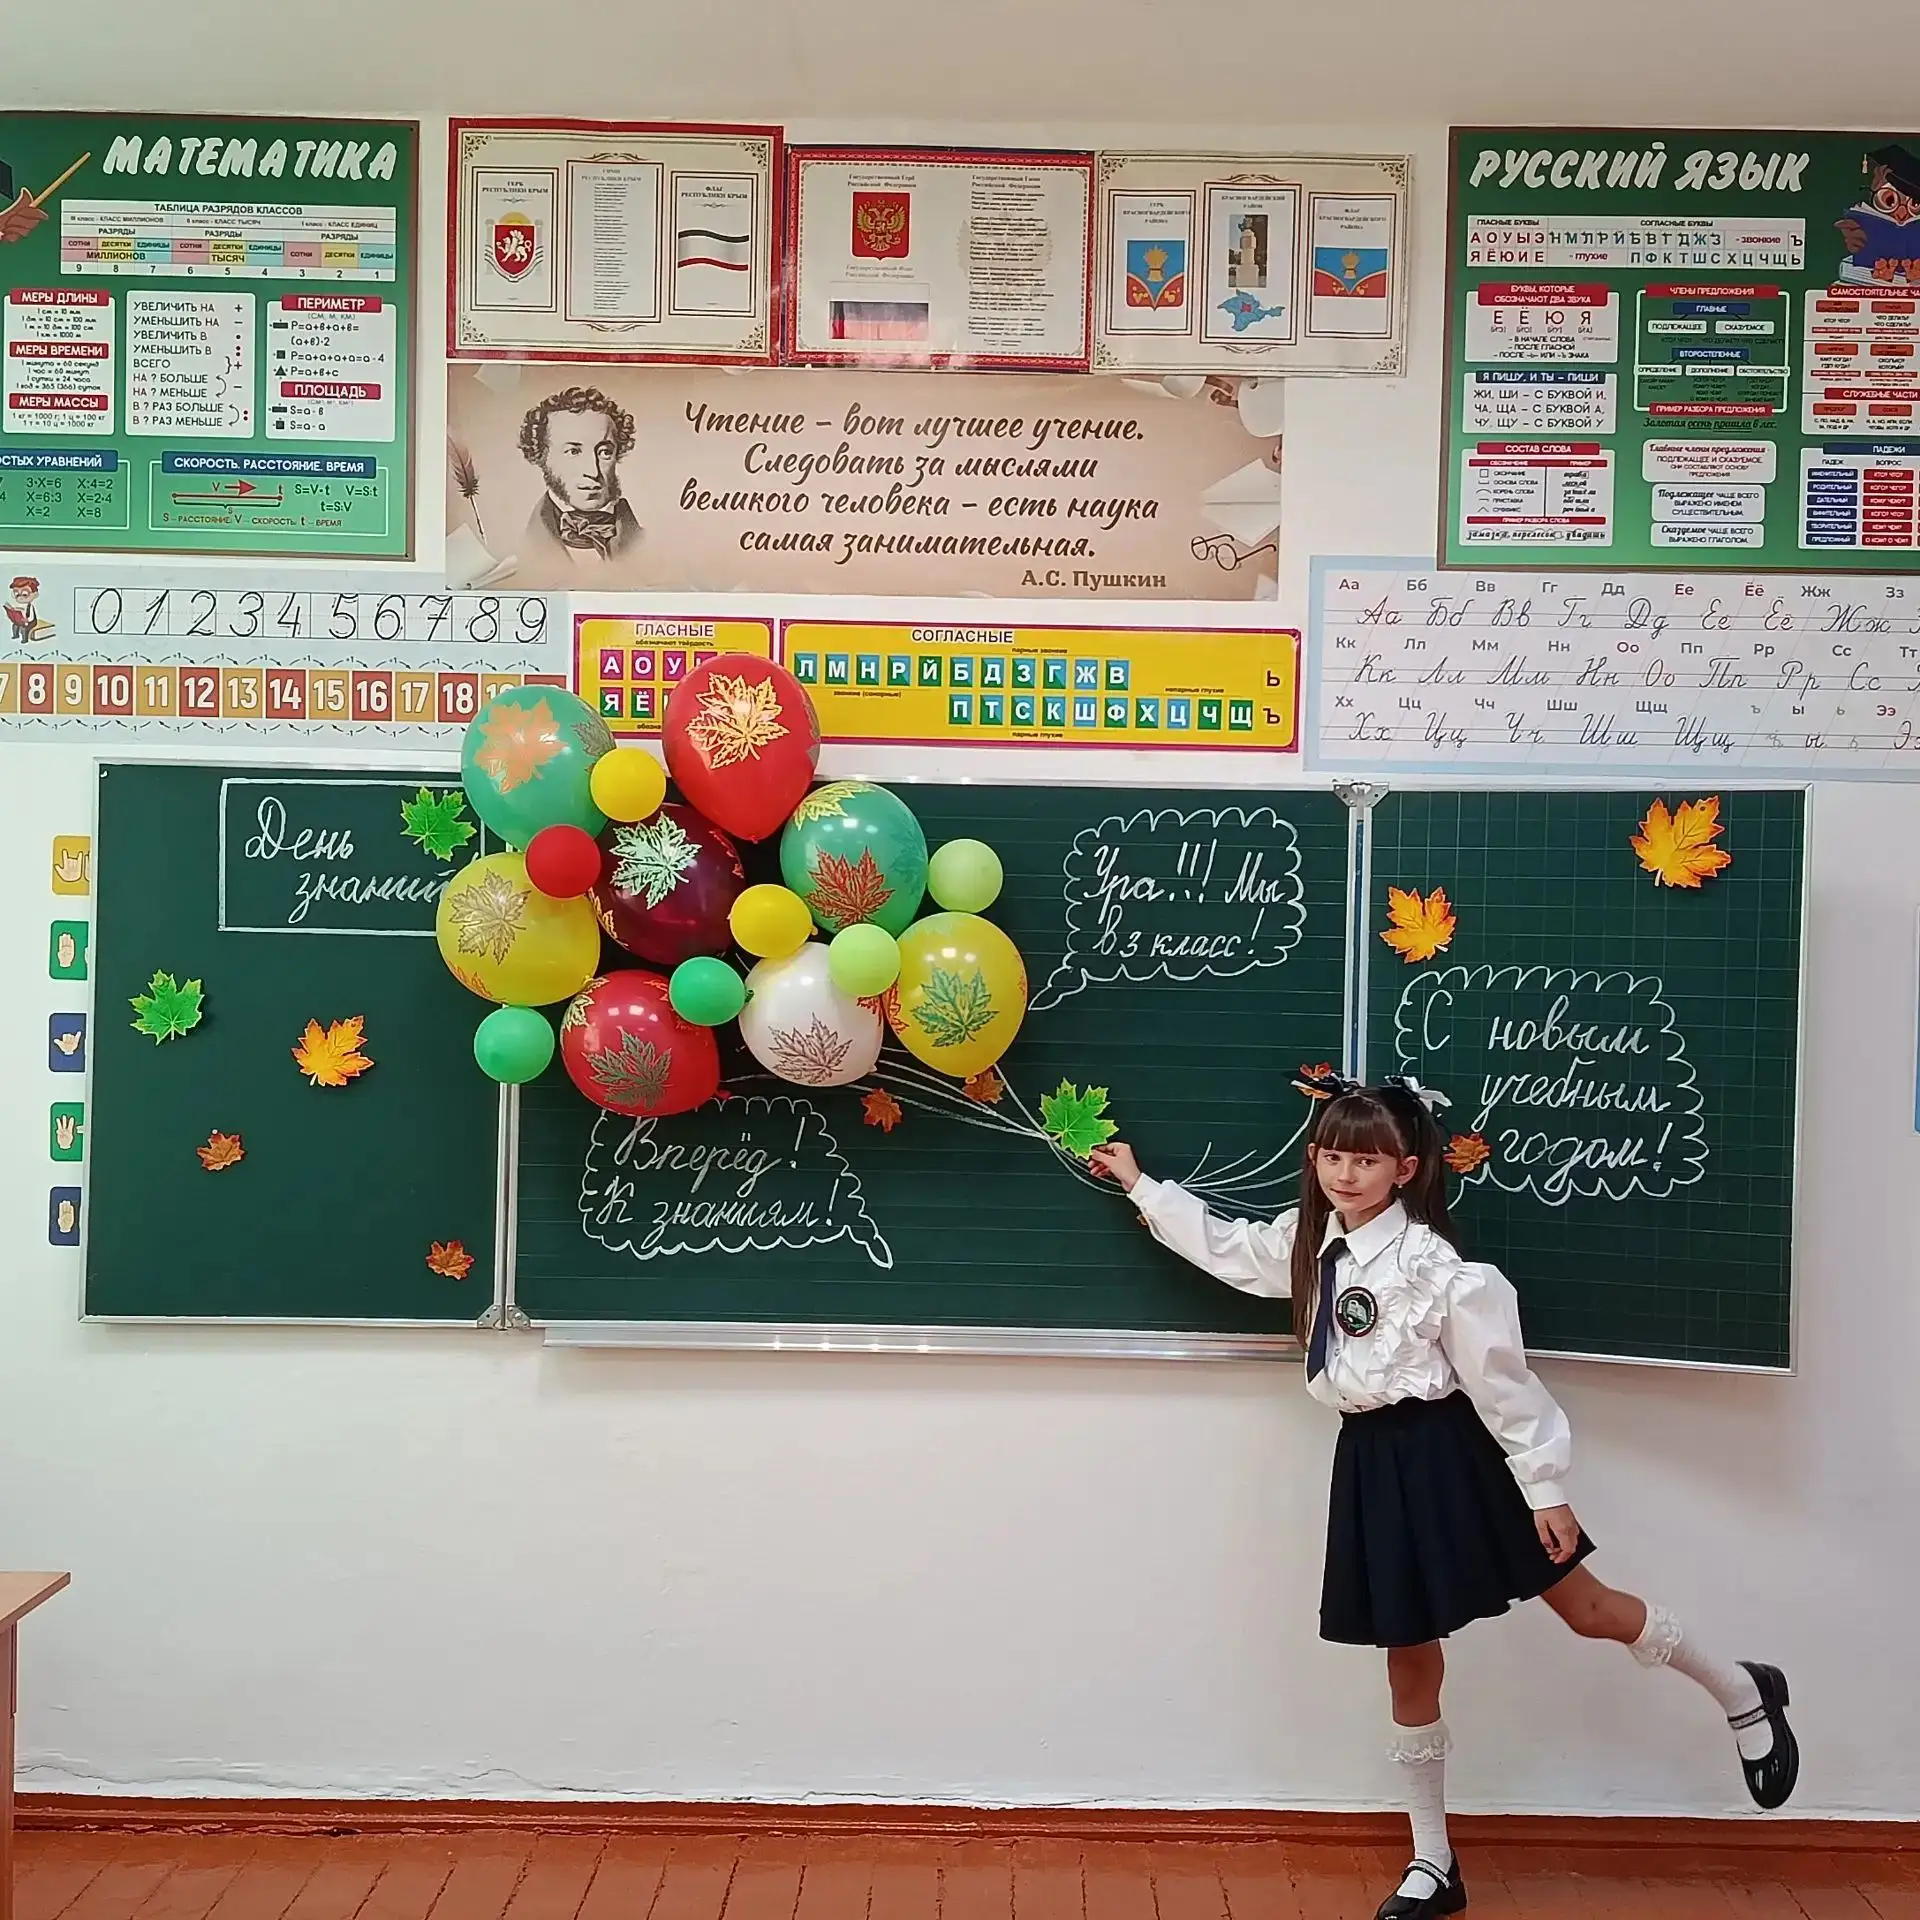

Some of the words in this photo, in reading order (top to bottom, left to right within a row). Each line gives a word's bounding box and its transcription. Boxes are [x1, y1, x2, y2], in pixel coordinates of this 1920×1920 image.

[102, 135, 397, 181] МАТЕМАТИКА
[1470, 141, 1667, 189] РУССКИЙ
[1675, 150, 1811, 192] ЯЗЫК
[154, 203, 200, 214] ТАБЛИЦА
[202, 204, 254, 215] РАЗРЯДОВ
[256, 206, 303, 216] КЛАССОВ
[98, 228, 136, 236] РАЗРЯДЫ
[204, 230, 243, 239] РАЗРЯДЫ
[321, 233, 359, 241] РАЗРЯДЫ
[86, 251, 146, 261] МИЛЛИОНОВ
[211, 254, 246, 263] ТЫСЯЧ
[1539, 285, 1575, 293] КОТОРЫЕ
[1669, 287, 1695, 295] ЧЛЕНЫ
[1697, 288, 1755, 296] ПРЕДЛОЖЕНИЯ
[1830, 288, 1909, 297] САМОСТОЯТЕЛЬНЫЕ
[22, 292, 53, 303] МЕРЫ
[57, 293, 98, 304] ДЛИНЫ
[297, 297, 366, 310] ПЕРИМЕТР
[1494, 295, 1548, 304] ОБОЗНАЧАЮТ
[1549, 296, 1565, 304] ДВА
[1567, 296, 1591, 304] ЗВУКА
[133, 301, 197, 312] УВЕЛИЧИТЬ
[200, 303, 215, 312] НА
[1696, 305, 1727, 313] ГЛАВНЫЕ
[133, 316, 202, 327] УМЕНЬШИТЬ
[205, 318, 220, 327] НА
[1652, 323, 1703, 331] ПОДЛЕЖАЩЕЕ
[133, 330, 197, 340] УВЕЛИЧИТЬ
[200, 331, 208, 341] В
[16, 345, 47, 355] МЕРЫ
[50, 346, 103, 356] ВРЕМЕНИ
[133, 344, 202, 355] УМЕНЬШИТЬ
[205, 346, 212, 355] В
[133, 359, 171, 368] ВСЕГО
[133, 373, 147, 382] НА
[160, 374, 208, 384] БОЛЬШЕ
[1483, 373, 1490, 381] Я
[1492, 373, 1527, 383] ПИШУ,
[1541, 374, 1554, 382] ТЫ
[1567, 373, 1599, 382] ПИШИ
[133, 388, 147, 396] НА
[160, 388, 207, 398] МЕНЬШЕ
[294, 384, 367, 399] ПЛОЩАДЬ
[1473, 390, 1495, 400] ЖИ,
[1499, 390, 1518, 399] ШИ
[1534, 390, 1544, 399] С
[1547, 388, 1592, 400] БУКВОЙ
[1892, 391, 1918, 399] ЧАСТИ
[19, 397, 51, 407] МЕРЫ
[54, 398, 99, 408] МАССЫ
[684, 401, 805, 437] Чтение
[843, 401, 904, 437] вот
[913, 417, 1023, 452] лучшее
[1032, 417, 1144, 453] учение.
[1505, 445, 1540, 454] СОСТАВ
[1541, 445, 1572, 454] СЛОВА
[1873, 445, 1906, 454] ПАДЕЖИ
[36, 454, 102, 468] УРАВНЕНИЙ
[174, 457, 241, 469] СКОРОСТЬ.
[243, 459, 323, 472] РАССТОЯНИЕ.
[326, 462, 364, 473] ВРЕМЯ
[744, 442, 904, 486] Следовать
[914, 454, 944, 488] за
[955, 455, 1101, 479] мыслями
[679, 478, 811, 516] великого
[821, 481, 950, 517] человека
[988, 495, 1057, 519] есть
[1068, 495, 1159, 531] наука
[739, 530, 833, 554] самая
[834, 531, 1095, 565] занимательная.
[1021, 569, 1067, 588] А.С.
[1072, 570, 1167, 591] Пушкин
[1338, 578, 1360, 590] Аа
[1406, 578, 1428, 592] Бб
[1475, 581, 1496, 593] Вв
[1542, 581, 1558, 593] Гг
[1601, 583, 1625, 596] Дд
[1675, 584, 1694, 596] Ее
[1745, 582, 1764, 597] Ёё
[1801, 586, 1832, 598] Жж
[1885, 587, 1905, 599] Зз
[91, 588, 122, 634] 0
[145, 589, 169, 635] 1
[186, 590, 217, 636] 2
[229, 591, 264, 637] 3
[278, 593, 301, 638] 4
[329, 593, 359, 640] 5
[374, 594, 406, 640] 6
[419, 595, 453, 641] 7
[469, 597, 500, 642] 8
[515, 597, 547, 643] 9
[635, 624, 714, 637] ГЛАСНЫЕ
[912, 629, 1014, 643] СОГЛАСНЫЕ
[1336, 637, 1356, 649] Кк
[1404, 639, 1427, 650] Лл
[1472, 640, 1499, 652] Мм
[1548, 640, 1571, 652] Нн
[1617, 642, 1640, 653] Оо
[1681, 643, 1703, 654] Пп
[1754, 644, 1775, 657] Рр
[1832, 645, 1852, 657] Сс
[27, 673, 47, 706] 8
[64, 674, 83, 706] 9
[97, 674, 130, 707] 10
[144, 676, 169, 707] 11
[184, 676, 215, 709] 12
[227, 677, 258, 709] 13
[270, 678, 302, 710] 14
[313, 679, 345, 712] 15
[356, 680, 388, 712] 16
[401, 682, 430, 714] 17
[442, 682, 474, 714] 18
[1335, 696, 1354, 708] Хх
[1399, 697, 1422, 710] Цц
[1474, 698, 1495, 710] Чч
[1547, 700, 1578, 711] Шш
[1636, 701, 1668, 714] Щщ
[1876, 704, 1896, 716] Ээ
[245, 796, 354, 860] День
[1225, 852, 1286, 904] Мы
[1092, 905, 1123, 955] в
[1120, 931, 1142, 959] 3
[1150, 907, 1265, 958] класс!
[1424, 990, 1453, 1051] С
[1488, 995, 1650, 1054] новым
[1471, 1056, 1672, 1133] учебным
[614, 1116, 805, 1198] Вперёд!
[1498, 1122, 1673, 1193] годом!
[596, 1176, 635, 1225] К
[641, 1178, 839, 1251] знаниям!
